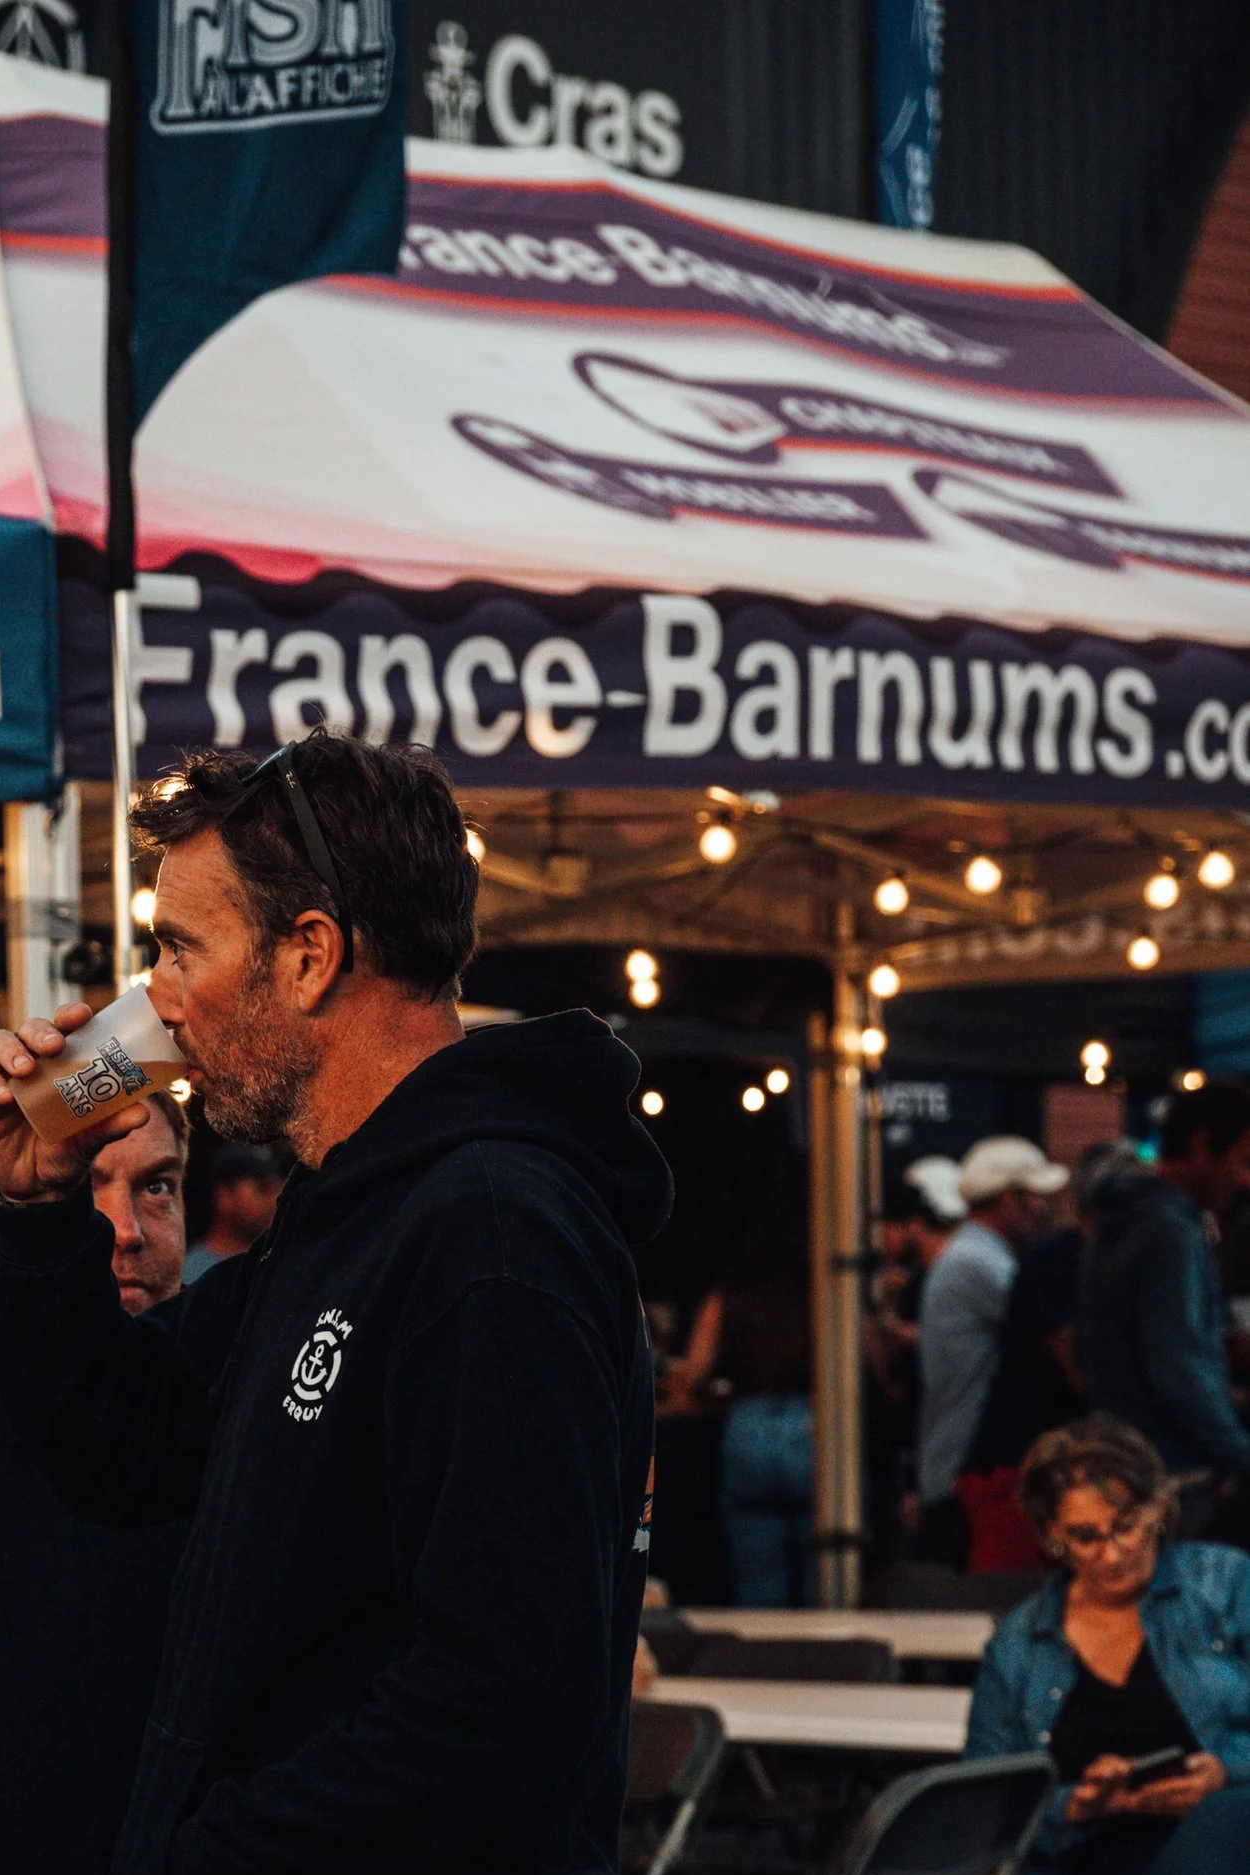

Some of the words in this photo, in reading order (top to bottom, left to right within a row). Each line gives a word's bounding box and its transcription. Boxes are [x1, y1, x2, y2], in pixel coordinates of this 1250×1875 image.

[484, 34, 684, 178] Cras
[53, 1074, 96, 1118] ANS
[78, 1058, 121, 1104] 10
[282, 1394, 324, 1422] ERQUY
